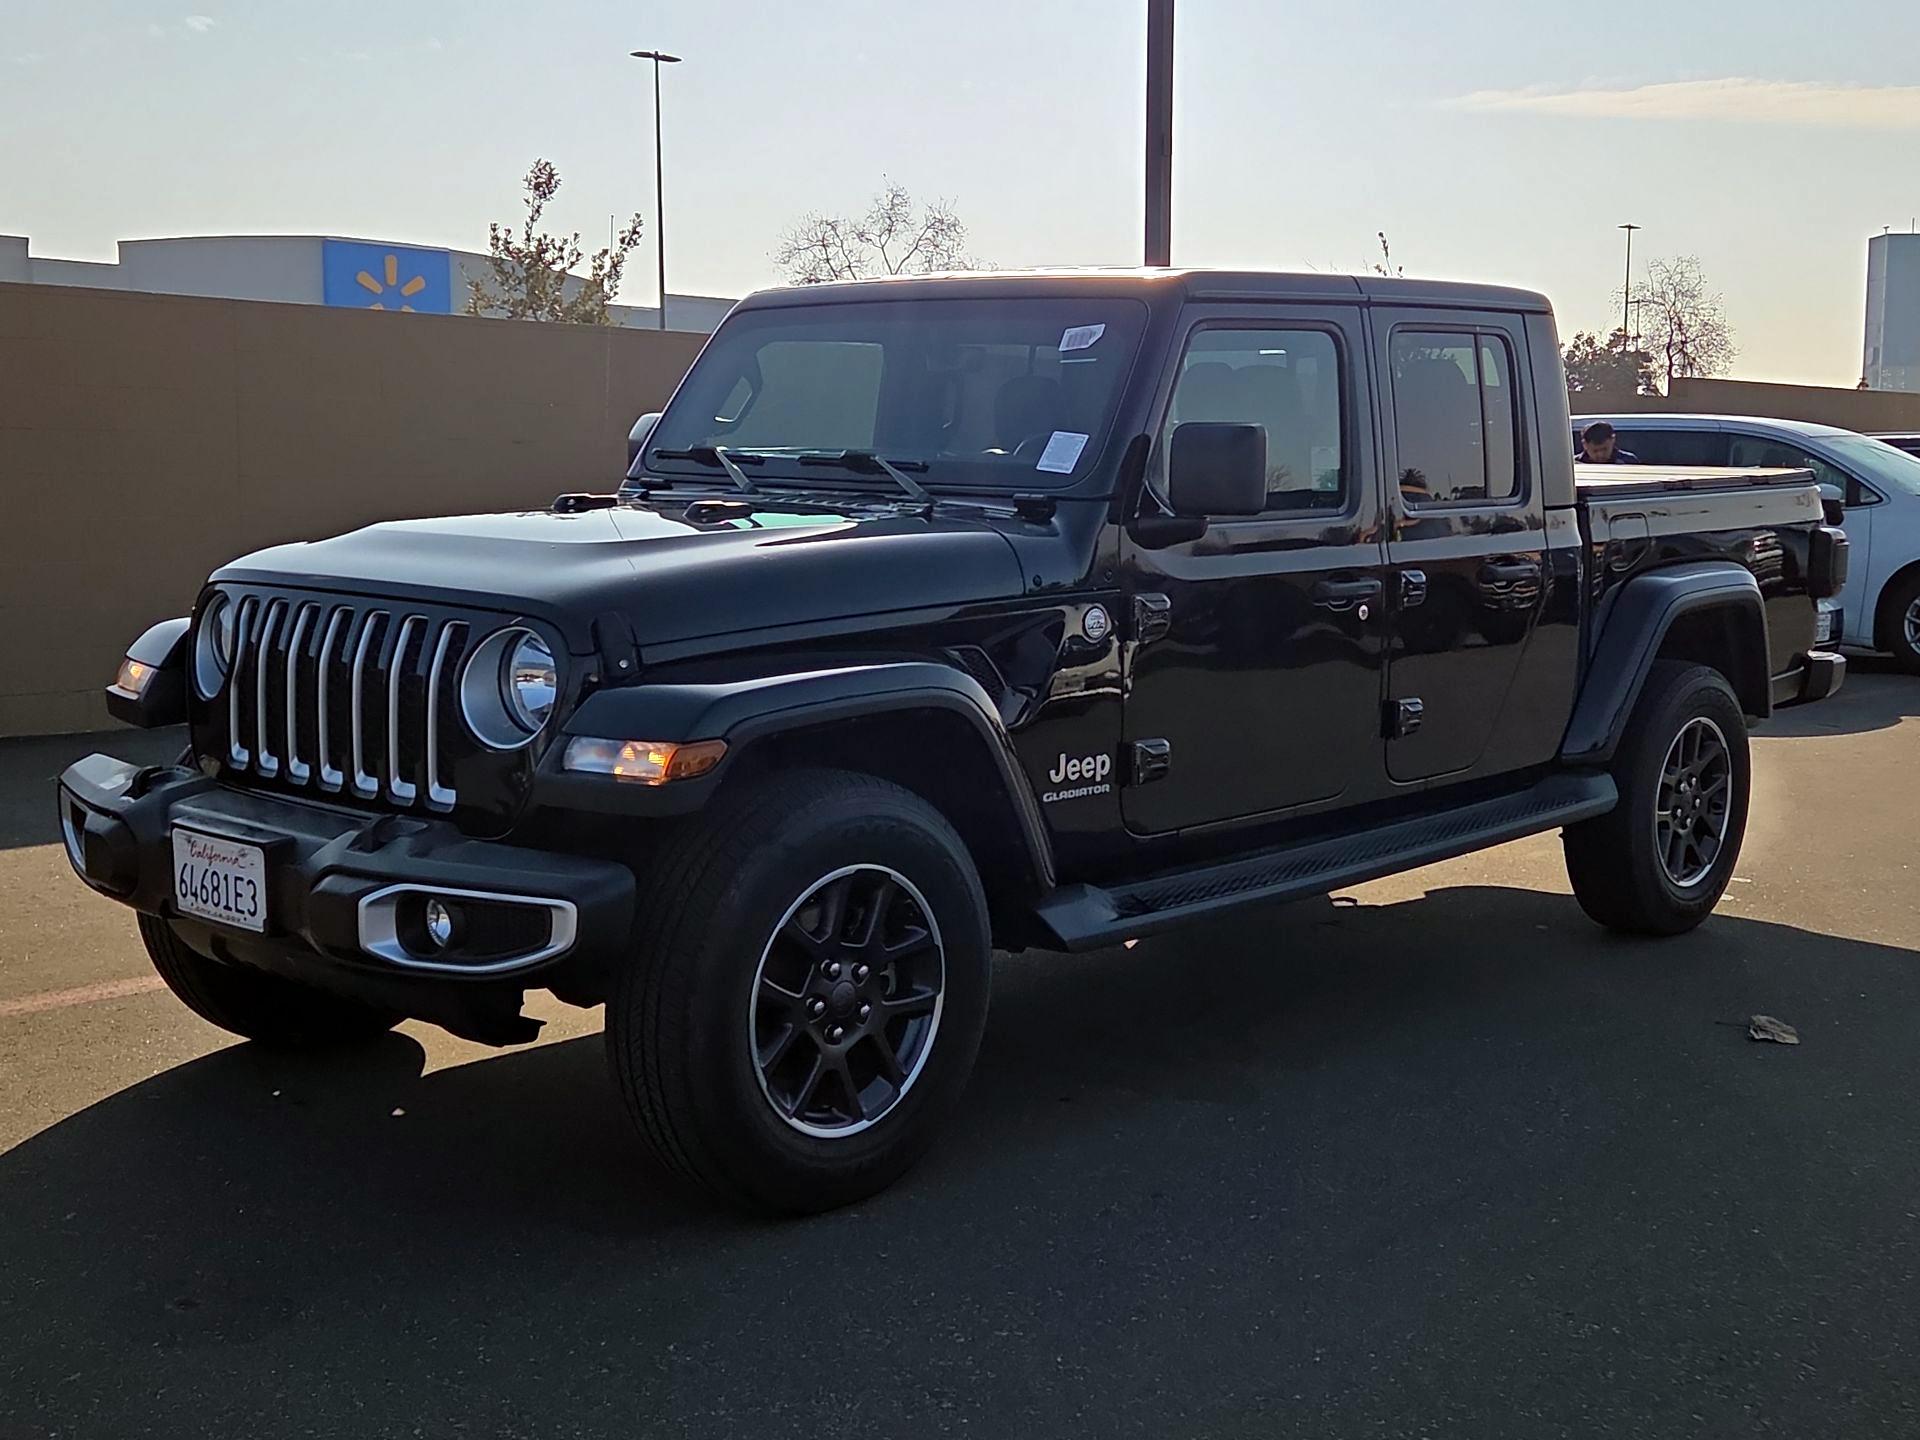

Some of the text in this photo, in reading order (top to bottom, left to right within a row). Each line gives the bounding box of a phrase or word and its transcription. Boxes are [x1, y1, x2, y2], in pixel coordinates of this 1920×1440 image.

[1049, 752, 1111, 783] Jeep
[1042, 783, 1111, 802] GLADIATOR
[190, 840, 246, 868] California
[179, 862, 258, 917] 64681E3
